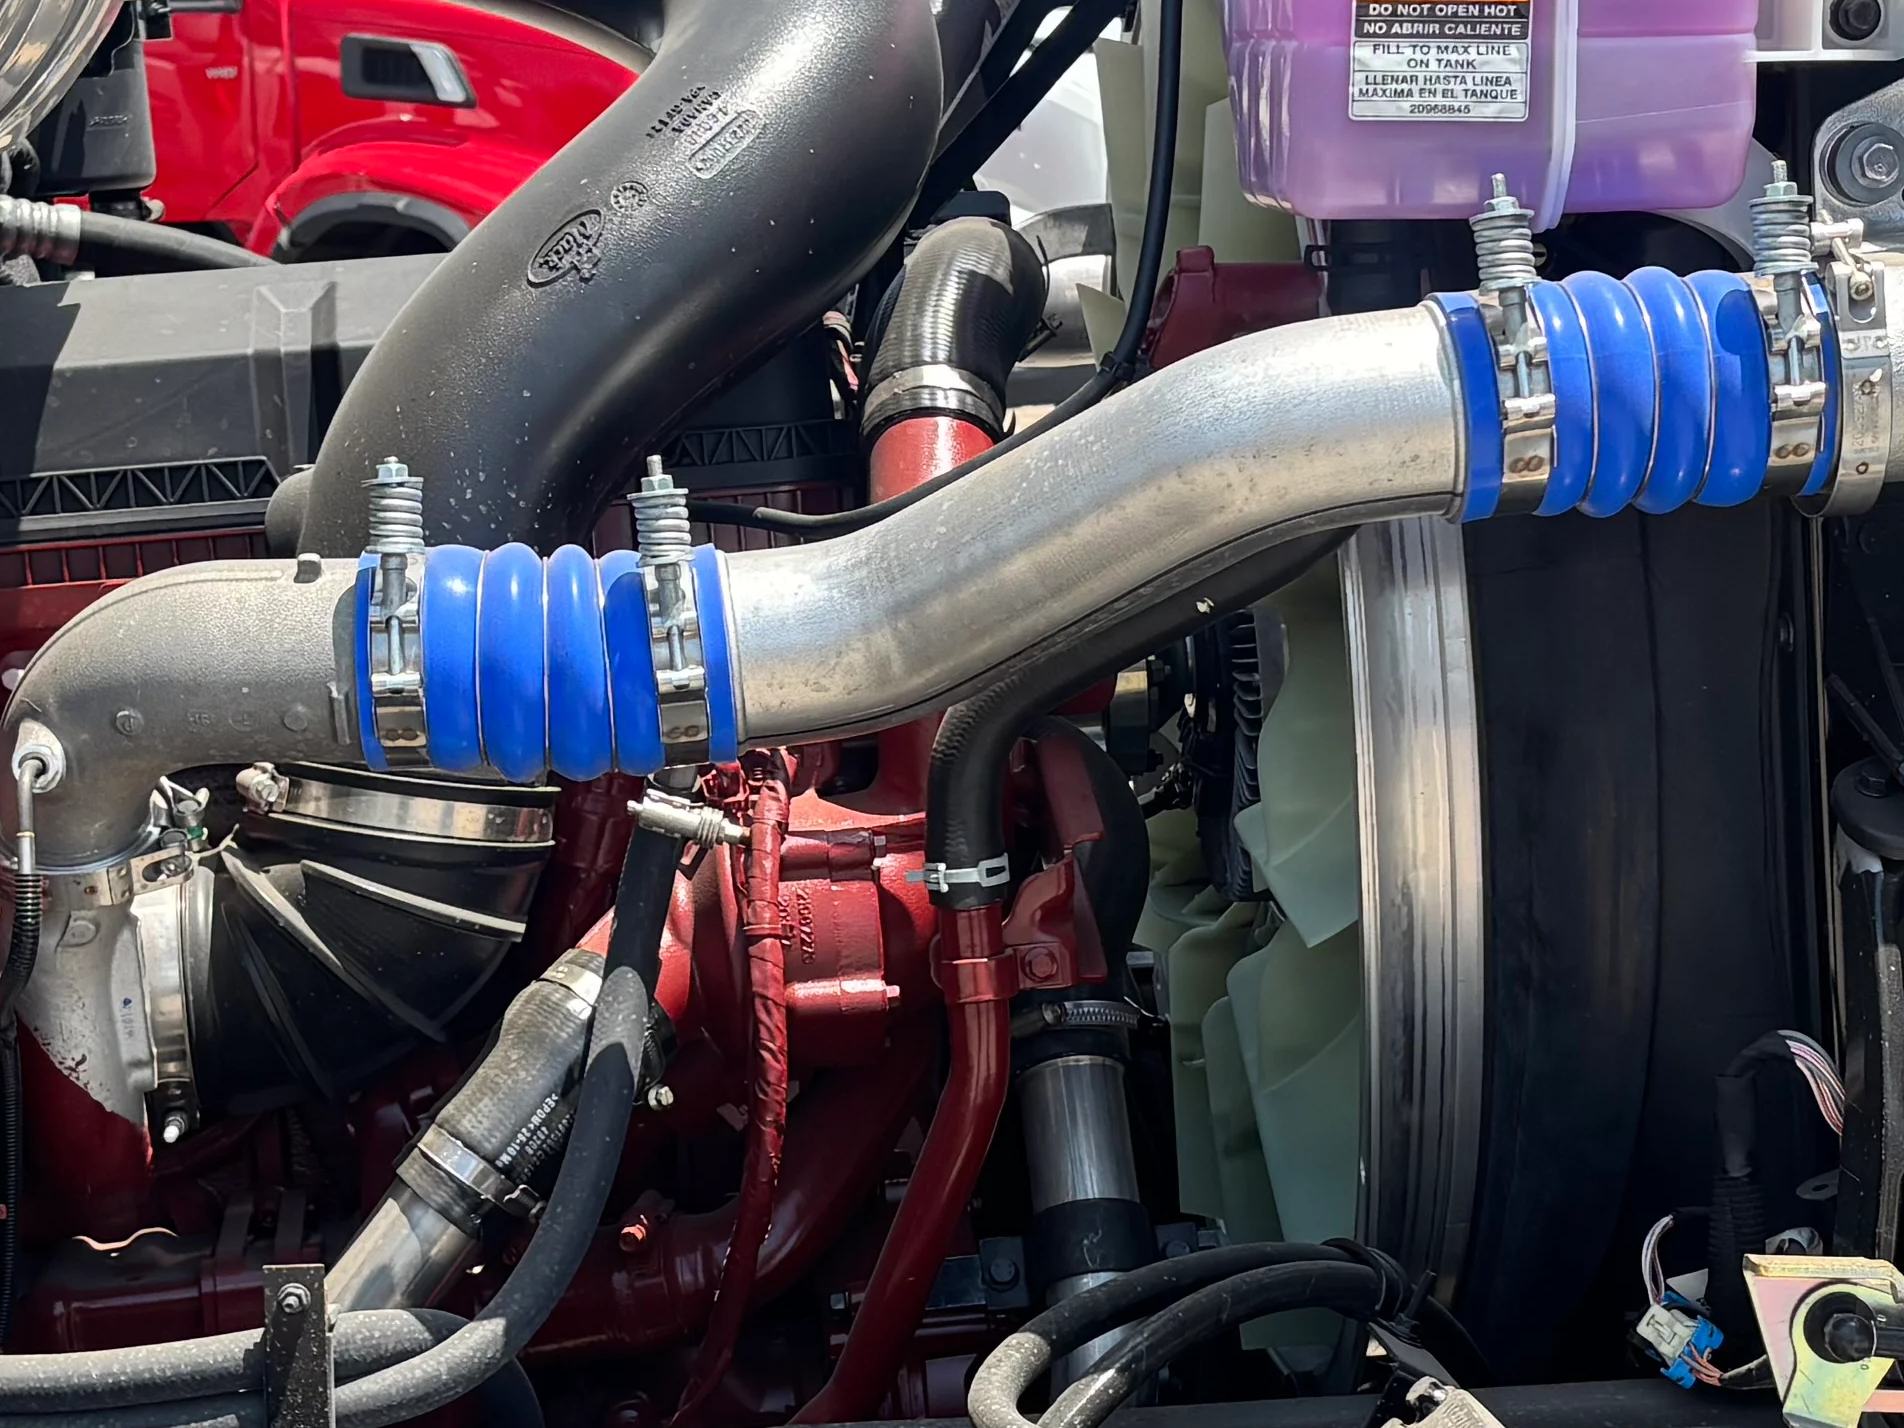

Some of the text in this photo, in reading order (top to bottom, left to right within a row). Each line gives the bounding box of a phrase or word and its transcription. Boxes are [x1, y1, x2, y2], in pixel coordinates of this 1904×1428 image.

[1369, 3, 1517, 17] DO NOT OPEN HOT
[1363, 22, 1521, 36] NO ABRIR CALIENTE
[1372, 43, 1511, 56] FILL TO MAX LINE
[1407, 58, 1477, 70] ON TANK
[1365, 75, 1418, 86] LLENAR
[1424, 75, 1467, 86] HASTA
[1419, 88, 1436, 98] EN
[1441, 88, 1458, 99] EL
[1463, 88, 1517, 100] TANQUE
